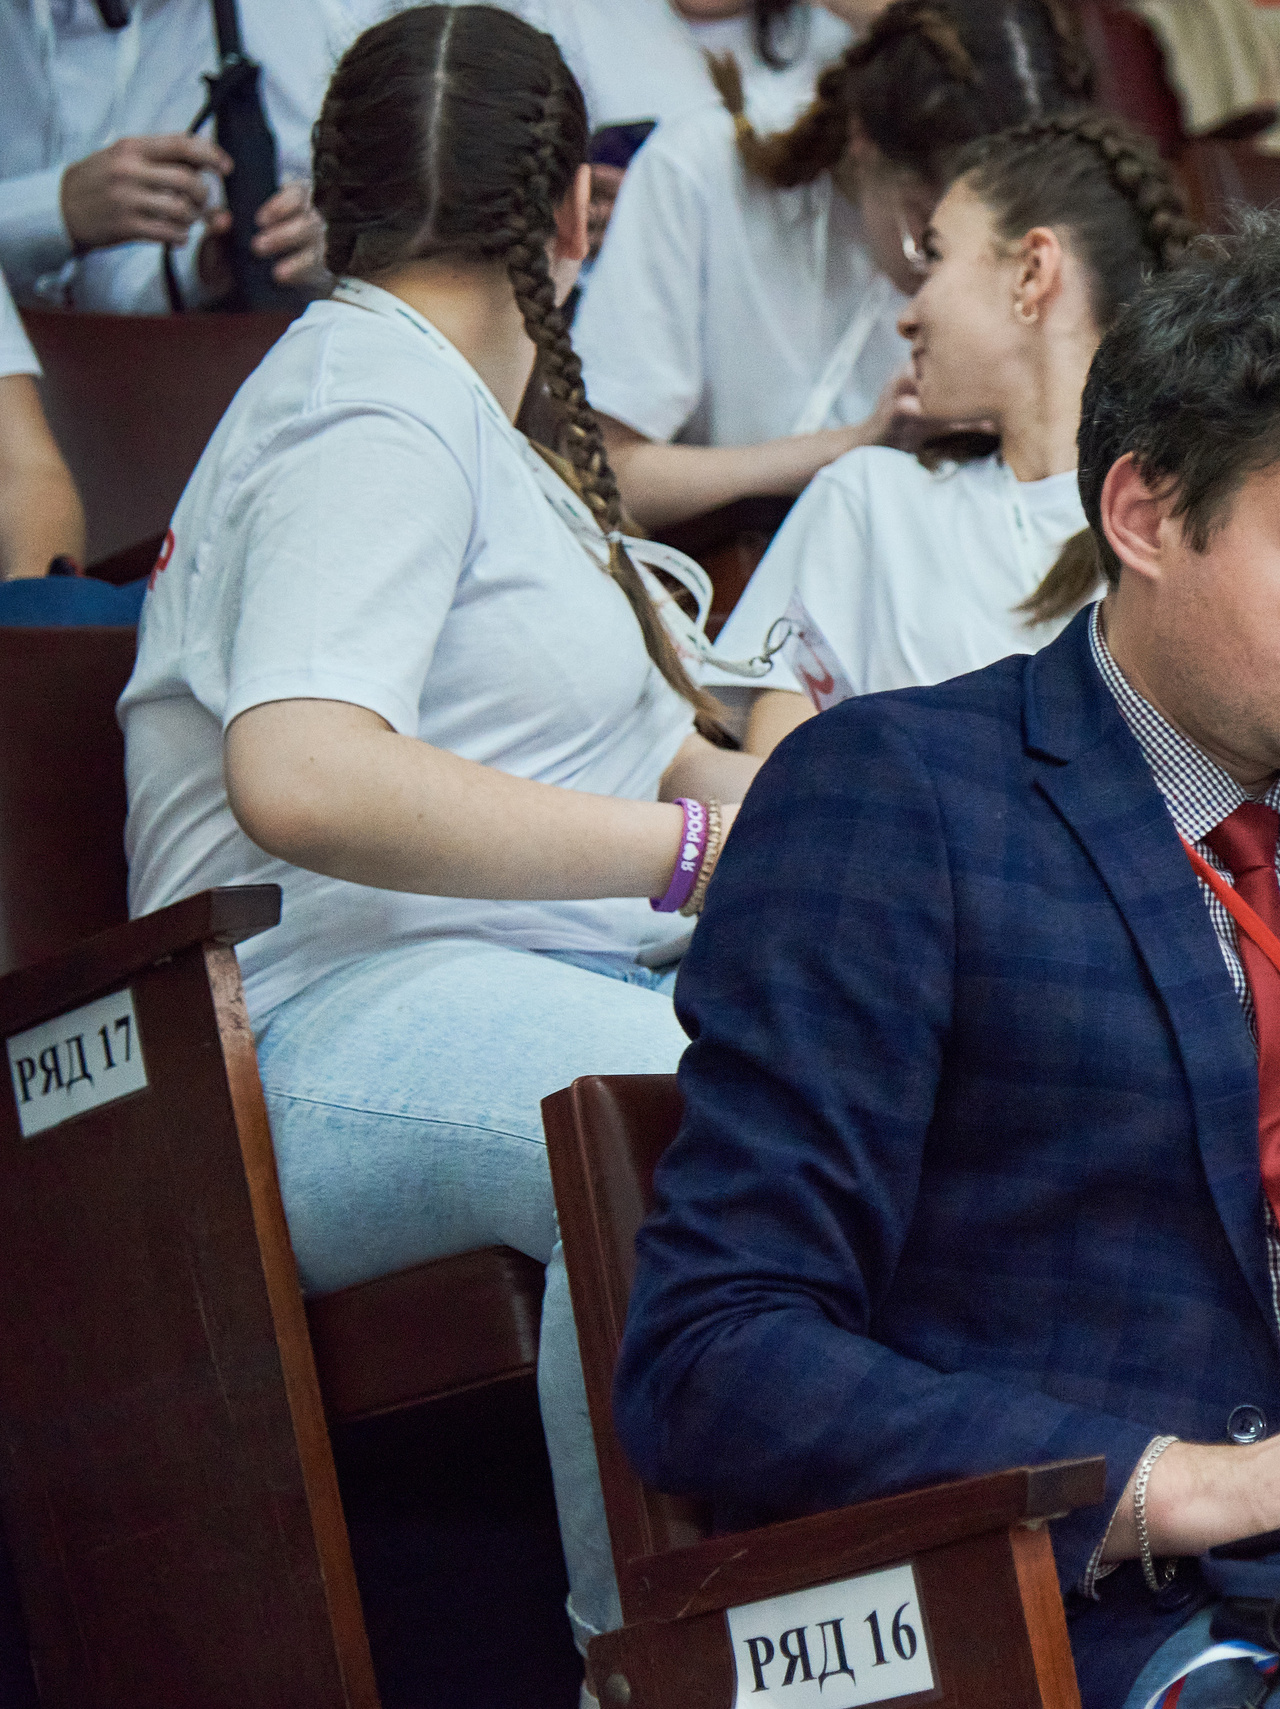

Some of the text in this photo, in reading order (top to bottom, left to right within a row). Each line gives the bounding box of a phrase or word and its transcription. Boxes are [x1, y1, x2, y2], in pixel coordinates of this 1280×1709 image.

[681, 860, 696, 873] Я
[16, 1014, 131, 1104] РЯД 17
[743, 1601, 918, 1694] РЯД 16
